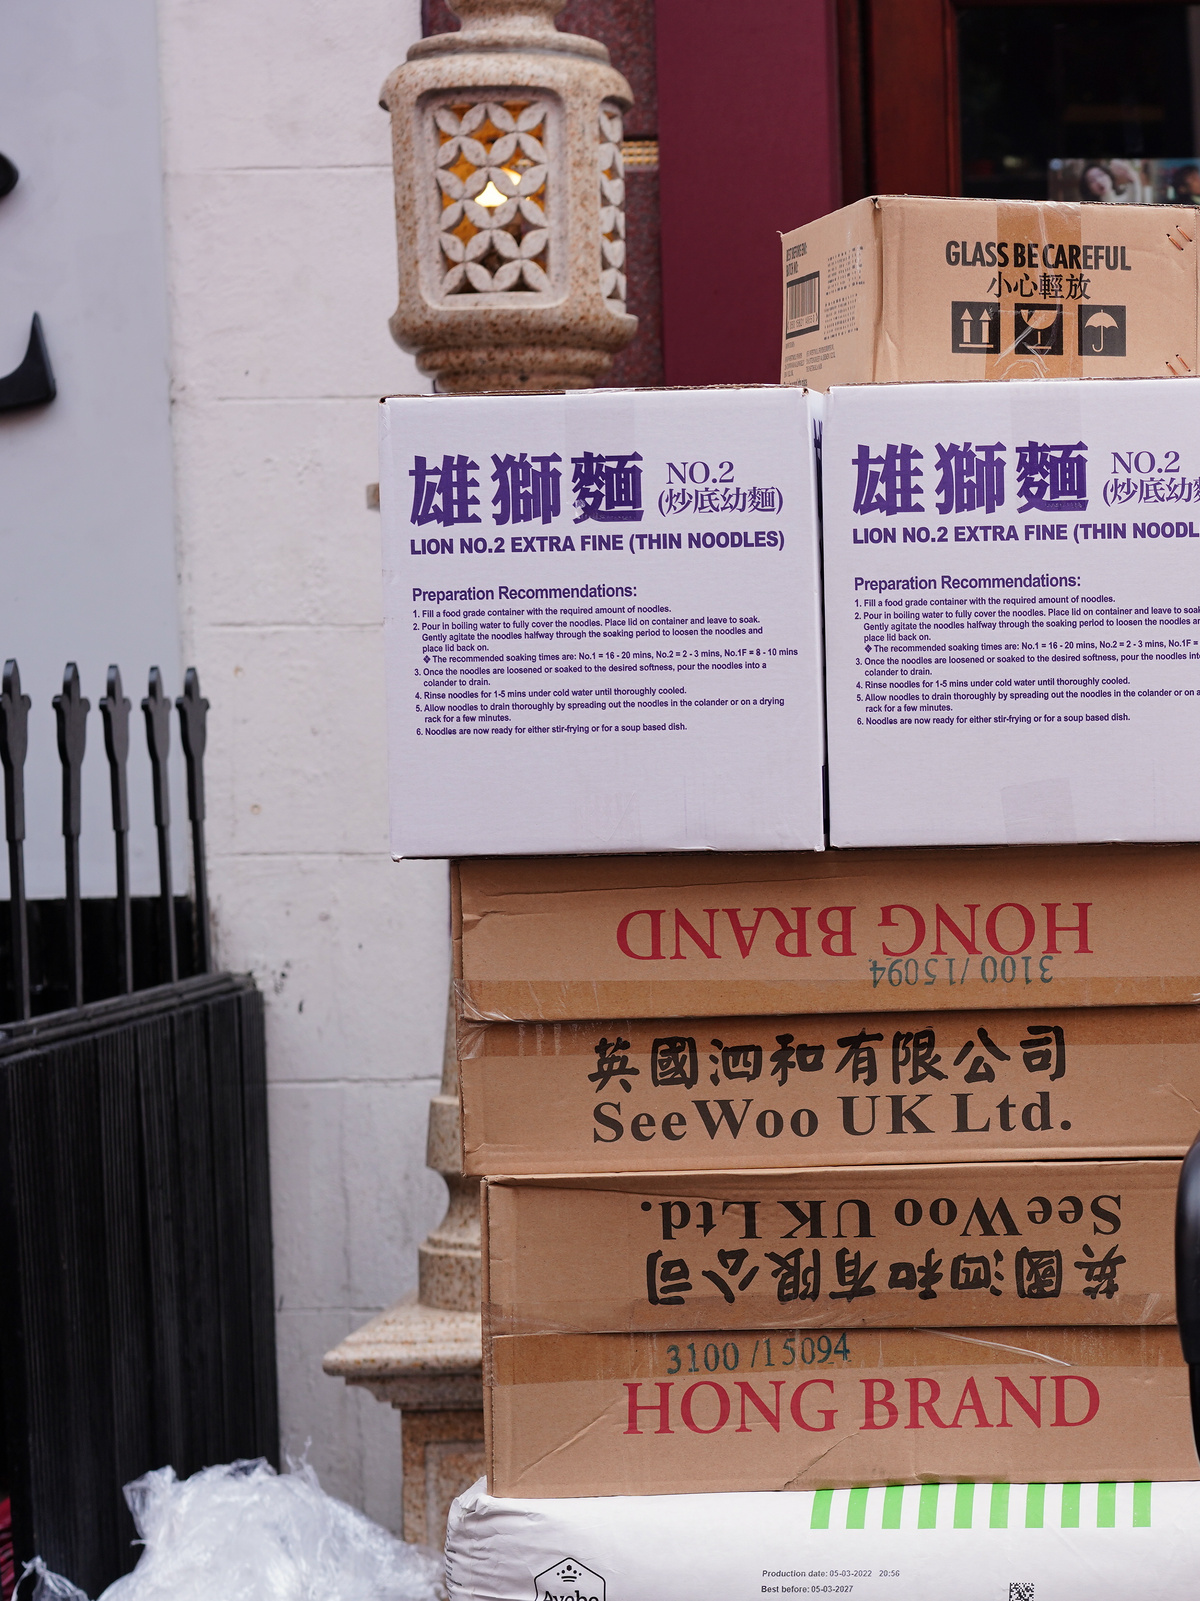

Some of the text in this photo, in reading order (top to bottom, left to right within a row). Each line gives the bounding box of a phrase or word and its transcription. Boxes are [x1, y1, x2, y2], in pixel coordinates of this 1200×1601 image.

[945, 240, 1132, 271] GLASS BE CAREFUL
[986, 271, 1091, 300] 小心輕放
[665, 461, 735, 484] NO.2
[1111, 450, 1180, 474] NO.2
[408, 451, 645, 527] 雄獅麵
[852, 440, 1089, 516] 雄獅麵
[658, 486, 783, 518] (炒底幼麵)
[410, 530, 784, 555] LION NO.2 EXTRA FINE (THIN NOODLES)
[853, 527, 896, 544] LION
[902, 526, 948, 543] NO.2
[954, 525, 1019, 542] EXTRA
[1024, 524, 1068, 541] FINE
[1073, 523, 1126, 544] (THIN
[412, 584, 637, 605] Preparation Recommendations:
[854, 574, 1081, 594] Preparation Recommendations:
[413, 609, 420, 618] 1.
[422, 610, 434, 618] Fill
[442, 609, 461, 617] food
[462, 609, 486, 619] grade
[487, 608, 525, 617] container
[526, 607, 543, 615] with
[545, 607, 558, 615] the
[560, 606, 593, 616] required
[595, 606, 625, 614] amount
[627, 605, 636, 613] of
[637, 605, 671, 613] noodles.
[413, 622, 420, 631] 2.
[422, 622, 441, 630] Pour
[442, 622, 450, 630] in
[451, 621, 478, 631] boiling
[479, 621, 501, 629] water
[502, 621, 511, 629] to
[512, 620, 530, 630] fully
[555, 619, 568, 628] the
[569, 619, 603, 627] noodles.
[604, 618, 626, 626] Place
[628, 618, 638, 626] lid
[651, 617, 689, 626] container
[690, 616, 705, 625] and
[707, 616, 728, 624] leave
[729, 616, 737, 624] to
[739, 615, 760, 624] soak.
[863, 622, 889, 632] Gently
[891, 622, 917, 632] agitate
[919, 622, 932, 630] the
[933, 621, 965, 630] noodles
[966, 620, 997, 630] halfway
[998, 620, 1030, 630] through
[1031, 620, 1044, 628] the
[1046, 619, 1077, 629] soaking
[1079, 618, 1104, 629] period
[1116, 618, 1143, 626] loosen
[1144, 617, 1157, 626] the
[1159, 617, 1191, 625] noodles
[864, 634, 885, 643] place
[886, 633, 896, 641] lid
[898, 633, 917, 641] back
[855, 657, 862, 666] 3.
[864, 657, 885, 665] Once
[886, 657, 899, 665] the
[901, 656, 933, 665] noodles
[949, 655, 985, 664] loosened
[997, 654, 1025, 663] soaked
[1037, 654, 1050, 662] the
[1051, 654, 1081, 662] desired
[1082, 653, 1119, 662] softness,
[1121, 654, 1139, 662] pour
[1140, 652, 1154, 660] the
[1155, 652, 1187, 660] noodles
[415, 692, 422, 700] 4.
[424, 691, 446, 699] Rinse
[448, 690, 479, 699] noodles
[480, 690, 492, 698] for
[494, 690, 506, 698] 1-5
[507, 690, 526, 698] mins
[528, 689, 551, 697] under
[553, 688, 570, 697] cold
[595, 687, 612, 696] until
[613, 687, 657, 697] thoroughly
[658, 686, 687, 695] cooled.
[416, 728, 423, 736] 6.
[425, 727, 457, 736] Noodles
[491, 726, 513, 736] ready
[514, 725, 526, 734] for
[527, 725, 550, 734] either
[551, 724, 589, 735] stir-frying
[601, 724, 613, 732] for
[621, 725, 641, 733] soup
[642, 723, 666, 731] based
[668, 722, 687, 731] dish.
[616, 903, 1094, 961] HONG BRAND
[588, 1025, 1067, 1094] 英國泗和有限公司
[838, 1094, 935, 1135] UK
[951, 1091, 1071, 1133] Ltd.
[641, 1200, 762, 1241] Ltd.
[779, 1199, 876, 1239] UK
[622, 1375, 1100, 1435] HONG BRAND
[762, 1569, 901, 1578] Production date: 05-03-2022 20:56
[761, 1585, 854, 1593] Best before: 05-03-2027
